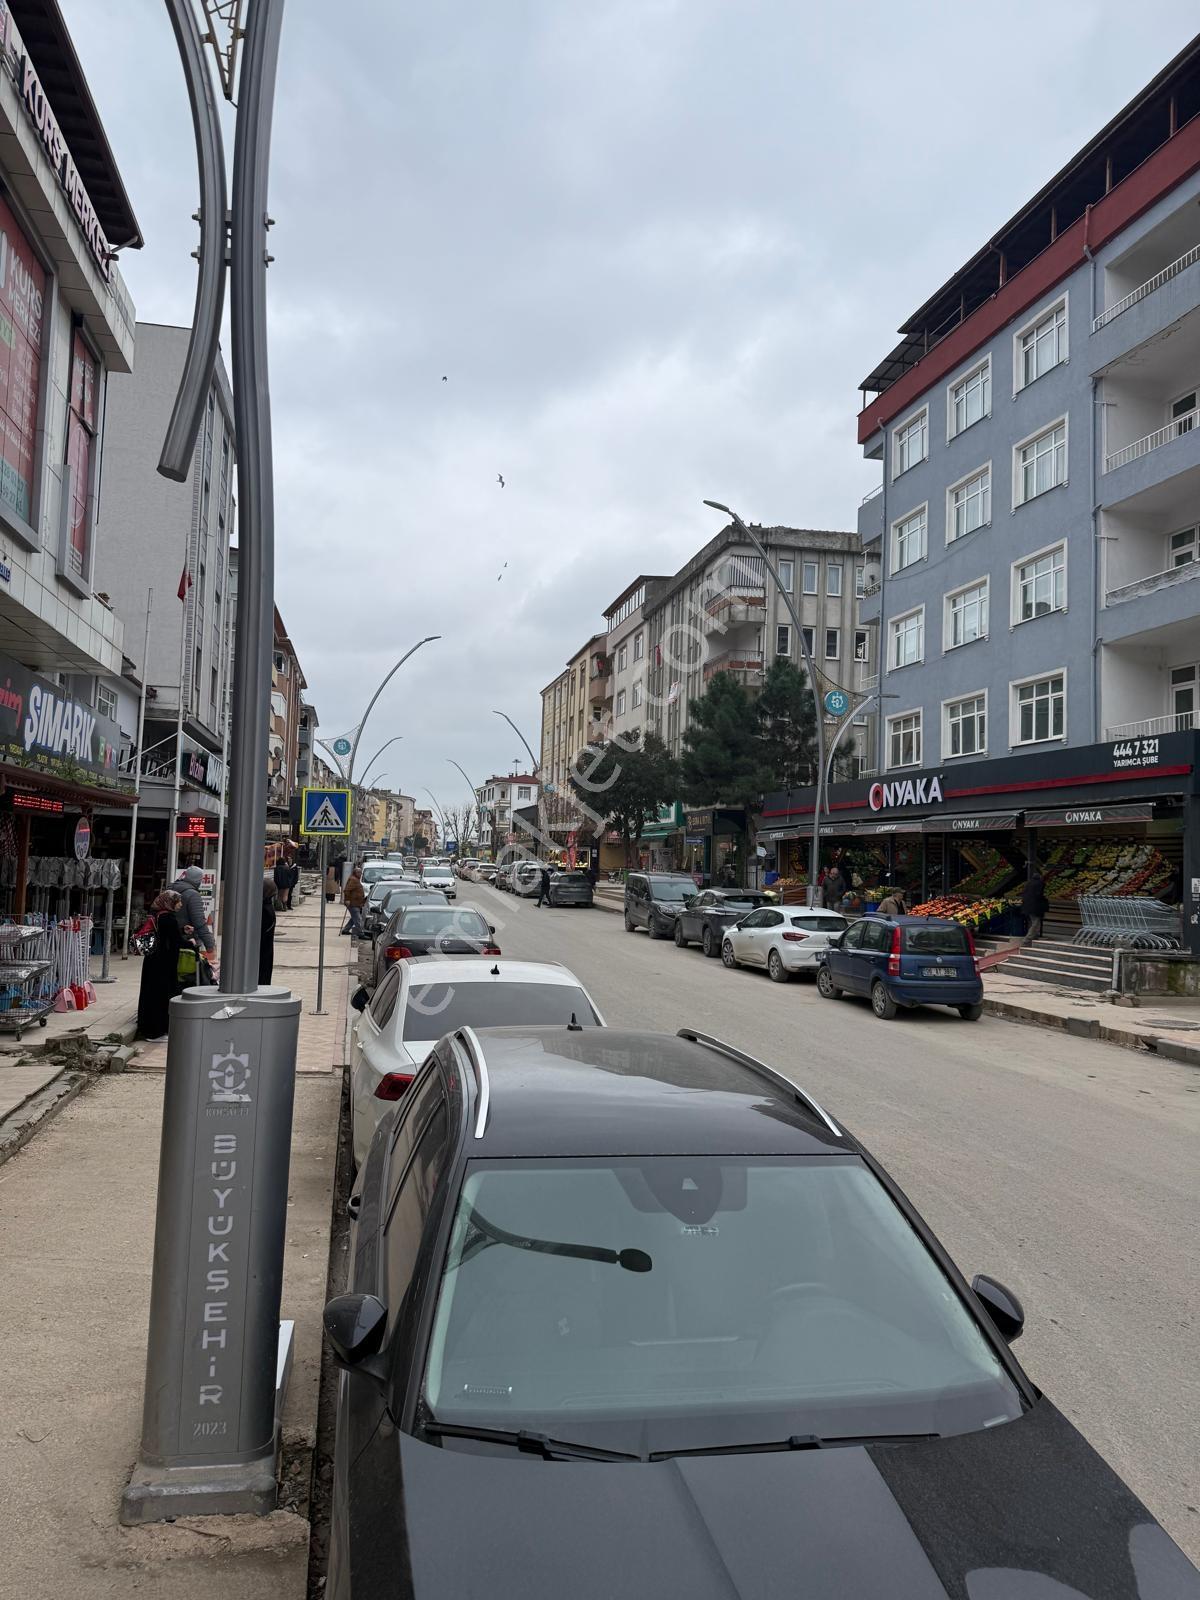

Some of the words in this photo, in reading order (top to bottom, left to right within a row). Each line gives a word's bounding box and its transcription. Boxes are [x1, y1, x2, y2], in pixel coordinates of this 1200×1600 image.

[20, 56, 62, 170] KURS
[11, 247, 43, 320] KURS
[1113, 742, 1133, 758] 444
[1134, 741, 1141, 756] 7
[1142, 738, 1159, 754] 321
[1113, 757, 1142, 768] YARIMCA
[1142, 755, 1159, 766] ŞUBE
[869, 776, 943, 811] ONYAKA
[952, 819, 980, 831] ONYAKA
[1065, 811, 1102, 823] ONYAKA
[192, 1421, 227, 1437] 2023
